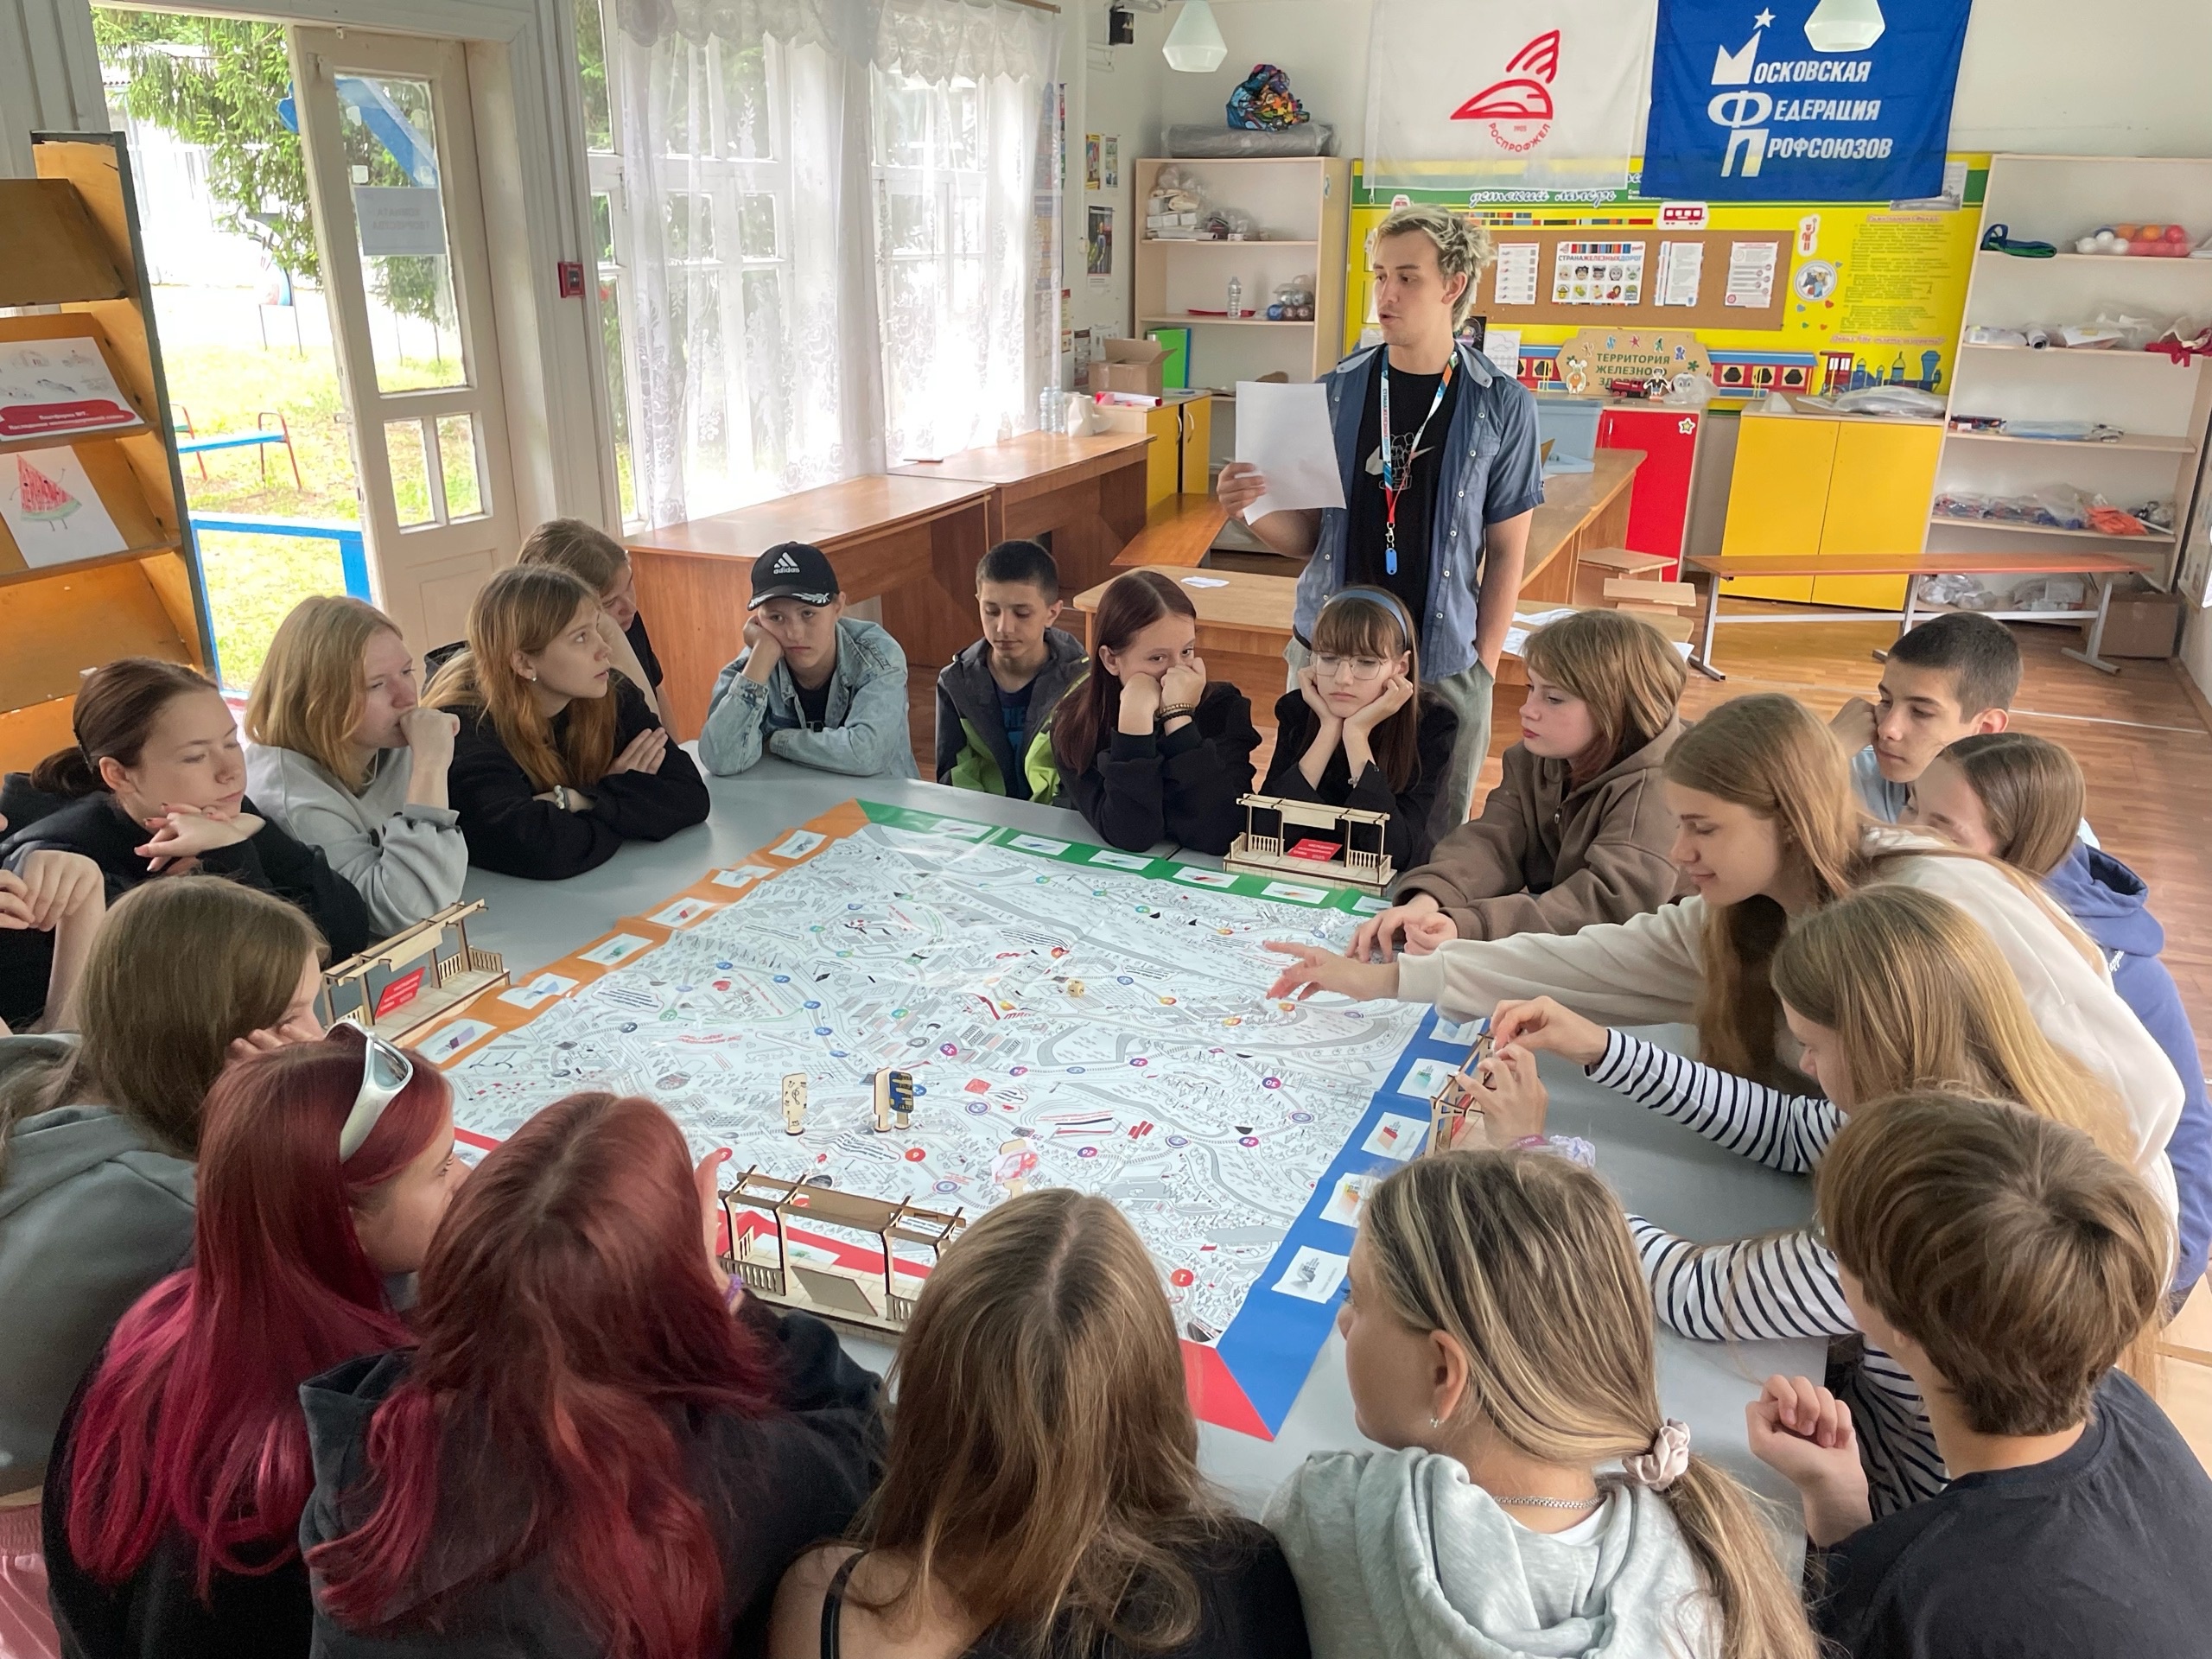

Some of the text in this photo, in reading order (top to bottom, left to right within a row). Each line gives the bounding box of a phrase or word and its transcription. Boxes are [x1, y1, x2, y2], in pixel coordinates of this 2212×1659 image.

[1711, 29, 1872, 85] МОСКОВСКАЯ
[1707, 90, 1881, 128] ФЕДЕРАЦИЯ
[1489, 122, 1551, 152] РОСПРОФЖЕЛ
[1720, 128, 1893, 177] ПРОФСОЮЗОВ
[1595, 365, 1668, 376] ЖЕЛЕЗНО
[1597, 353, 1670, 365] ТЕРРИТОРИЯ
[773, 566, 800, 575] adidas
